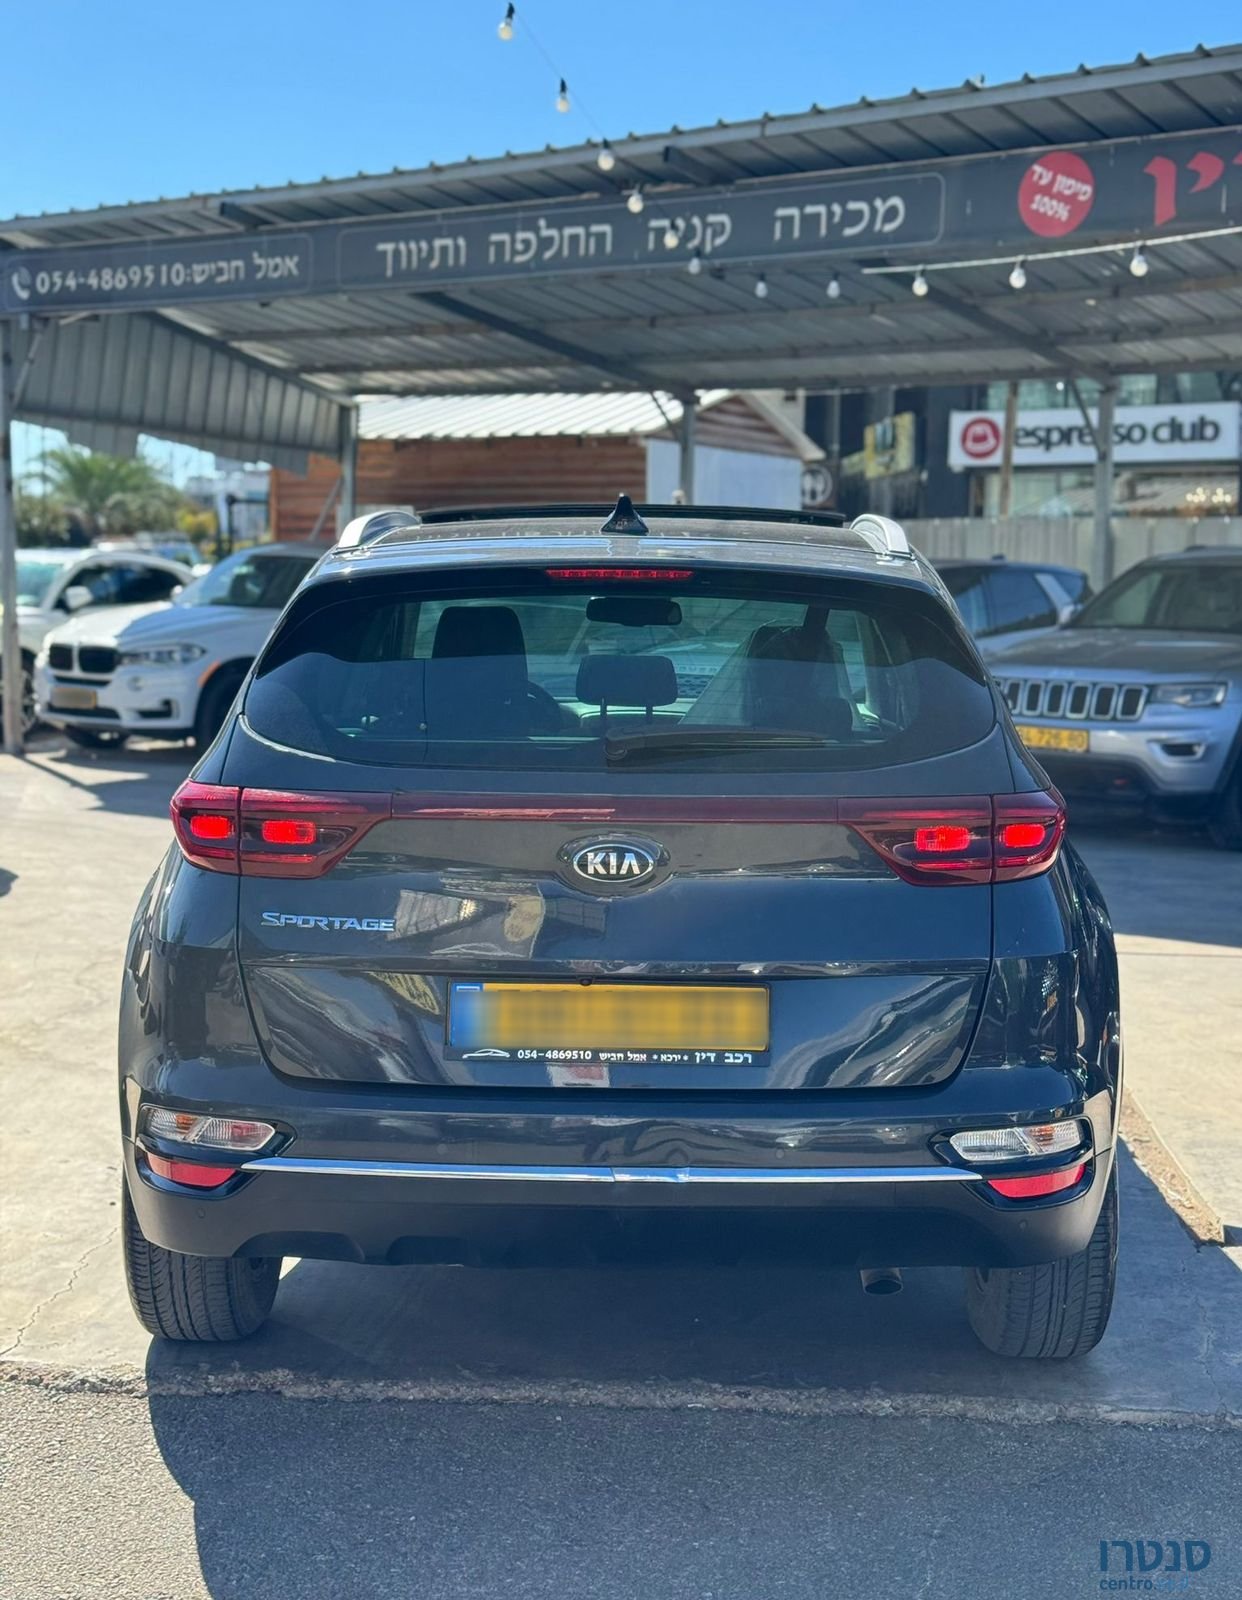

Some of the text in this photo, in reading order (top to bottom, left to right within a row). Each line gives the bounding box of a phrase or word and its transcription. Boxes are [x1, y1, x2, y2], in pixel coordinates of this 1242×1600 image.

[1143, 150, 1242, 226] ין
[772, 194, 907, 243] מכירה
[488, 217, 613, 264] החלפה
[647, 212, 732, 253] קניה
[252, 252, 300, 279] אמל
[1014, 415, 1221, 452] espreso club
[587, 852, 641, 875] KIA
[261, 911, 395, 932] SPORTAGE
[517, 1049, 592, 1060] 054-4869510
[599, 1051, 625, 1062] חביש
[627, 1051, 647, 1062] אמל
[694, 1051, 716, 1064] דין
[724, 1052, 753, 1064] רכב
